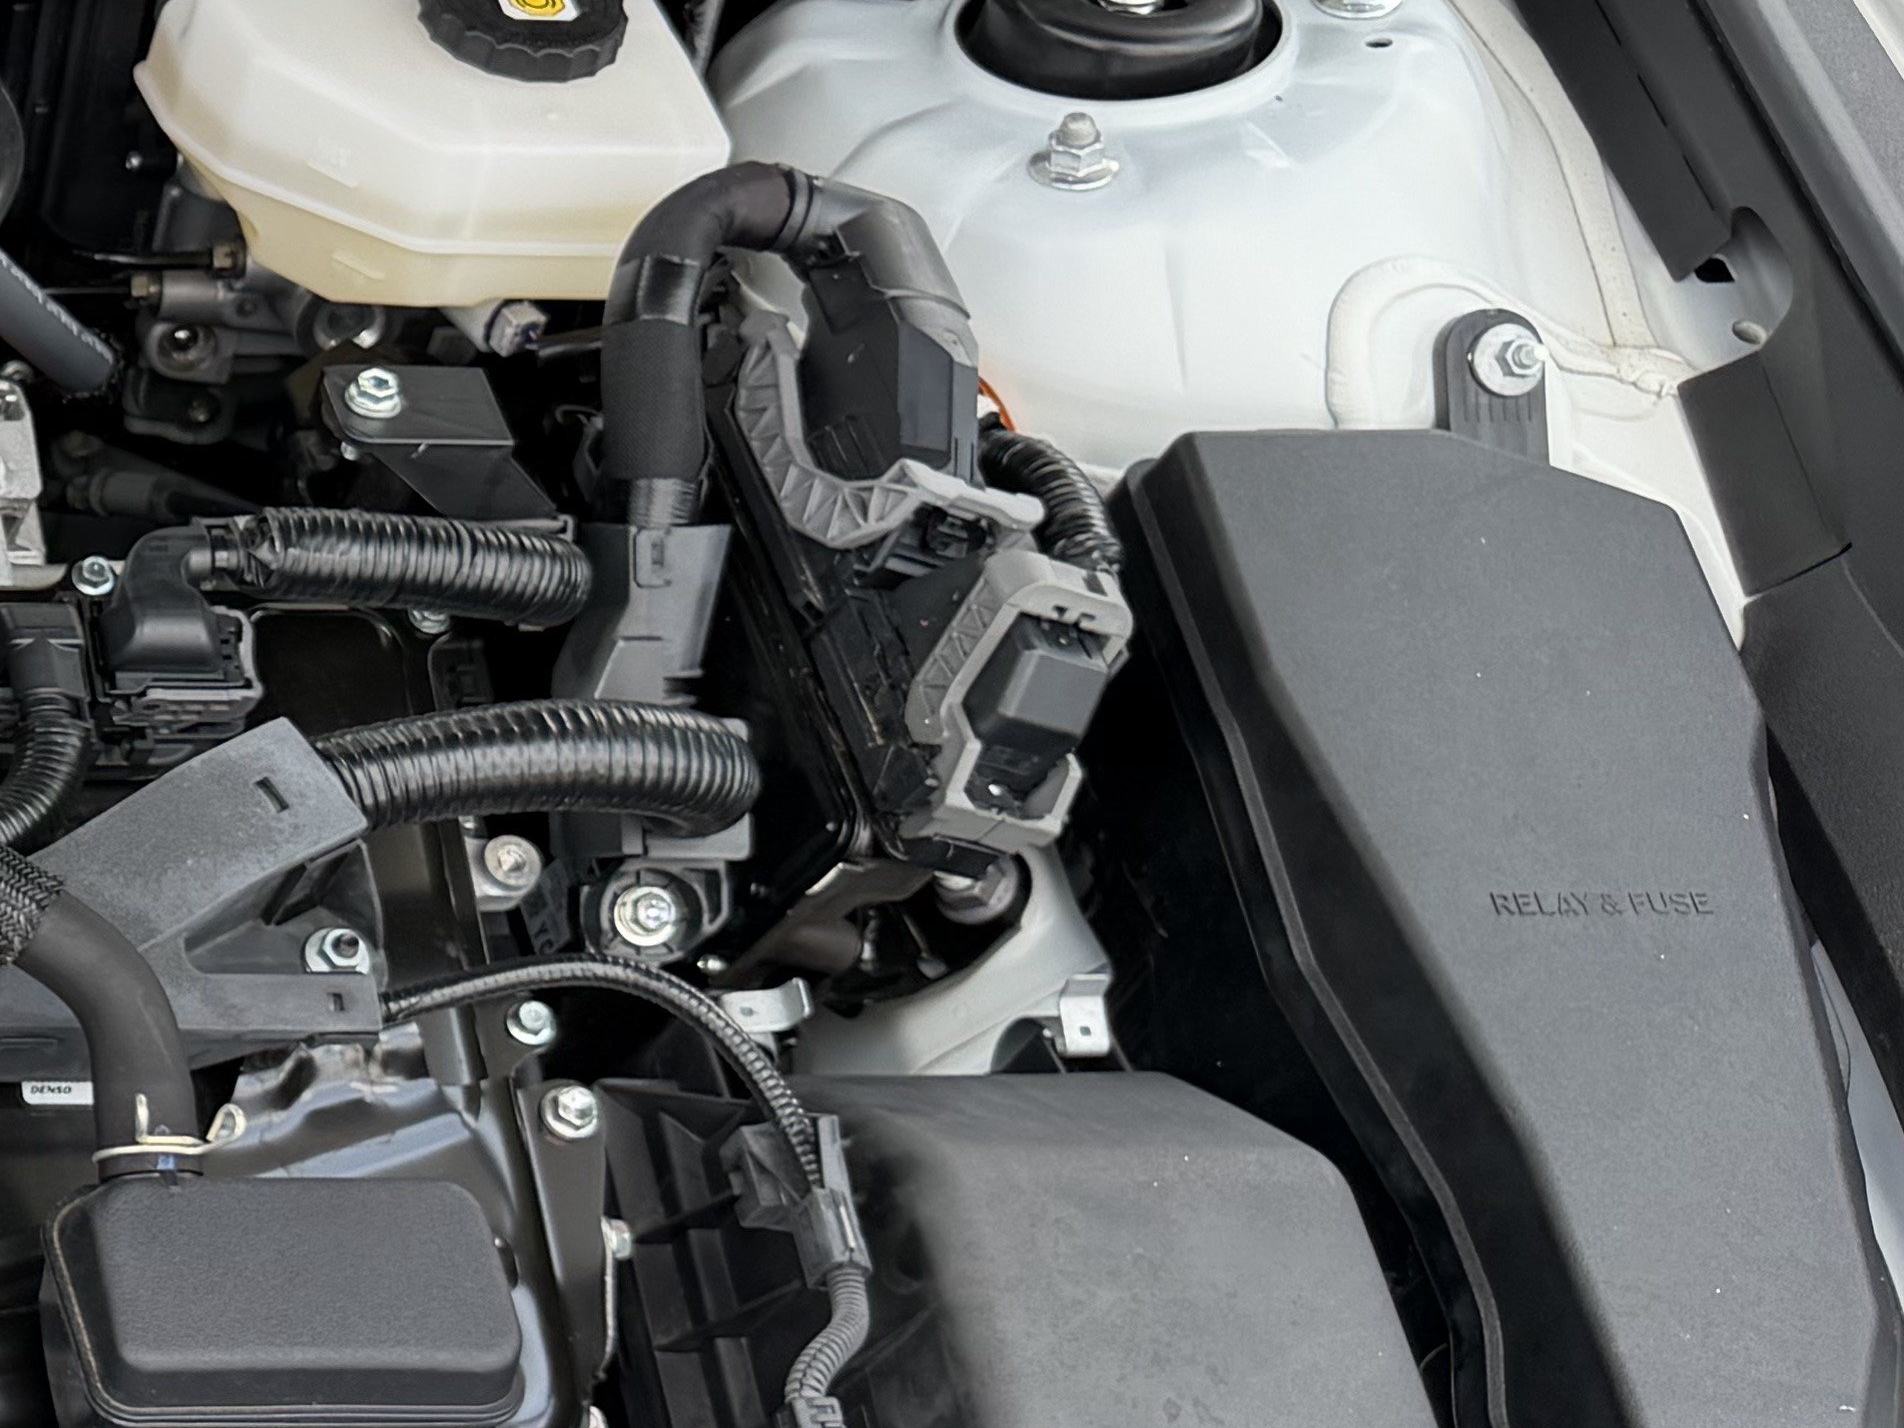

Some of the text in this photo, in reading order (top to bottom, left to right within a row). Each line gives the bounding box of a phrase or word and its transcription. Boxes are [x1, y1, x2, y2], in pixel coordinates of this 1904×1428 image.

[1489, 891, 1715, 917] RELAY & FUSE
